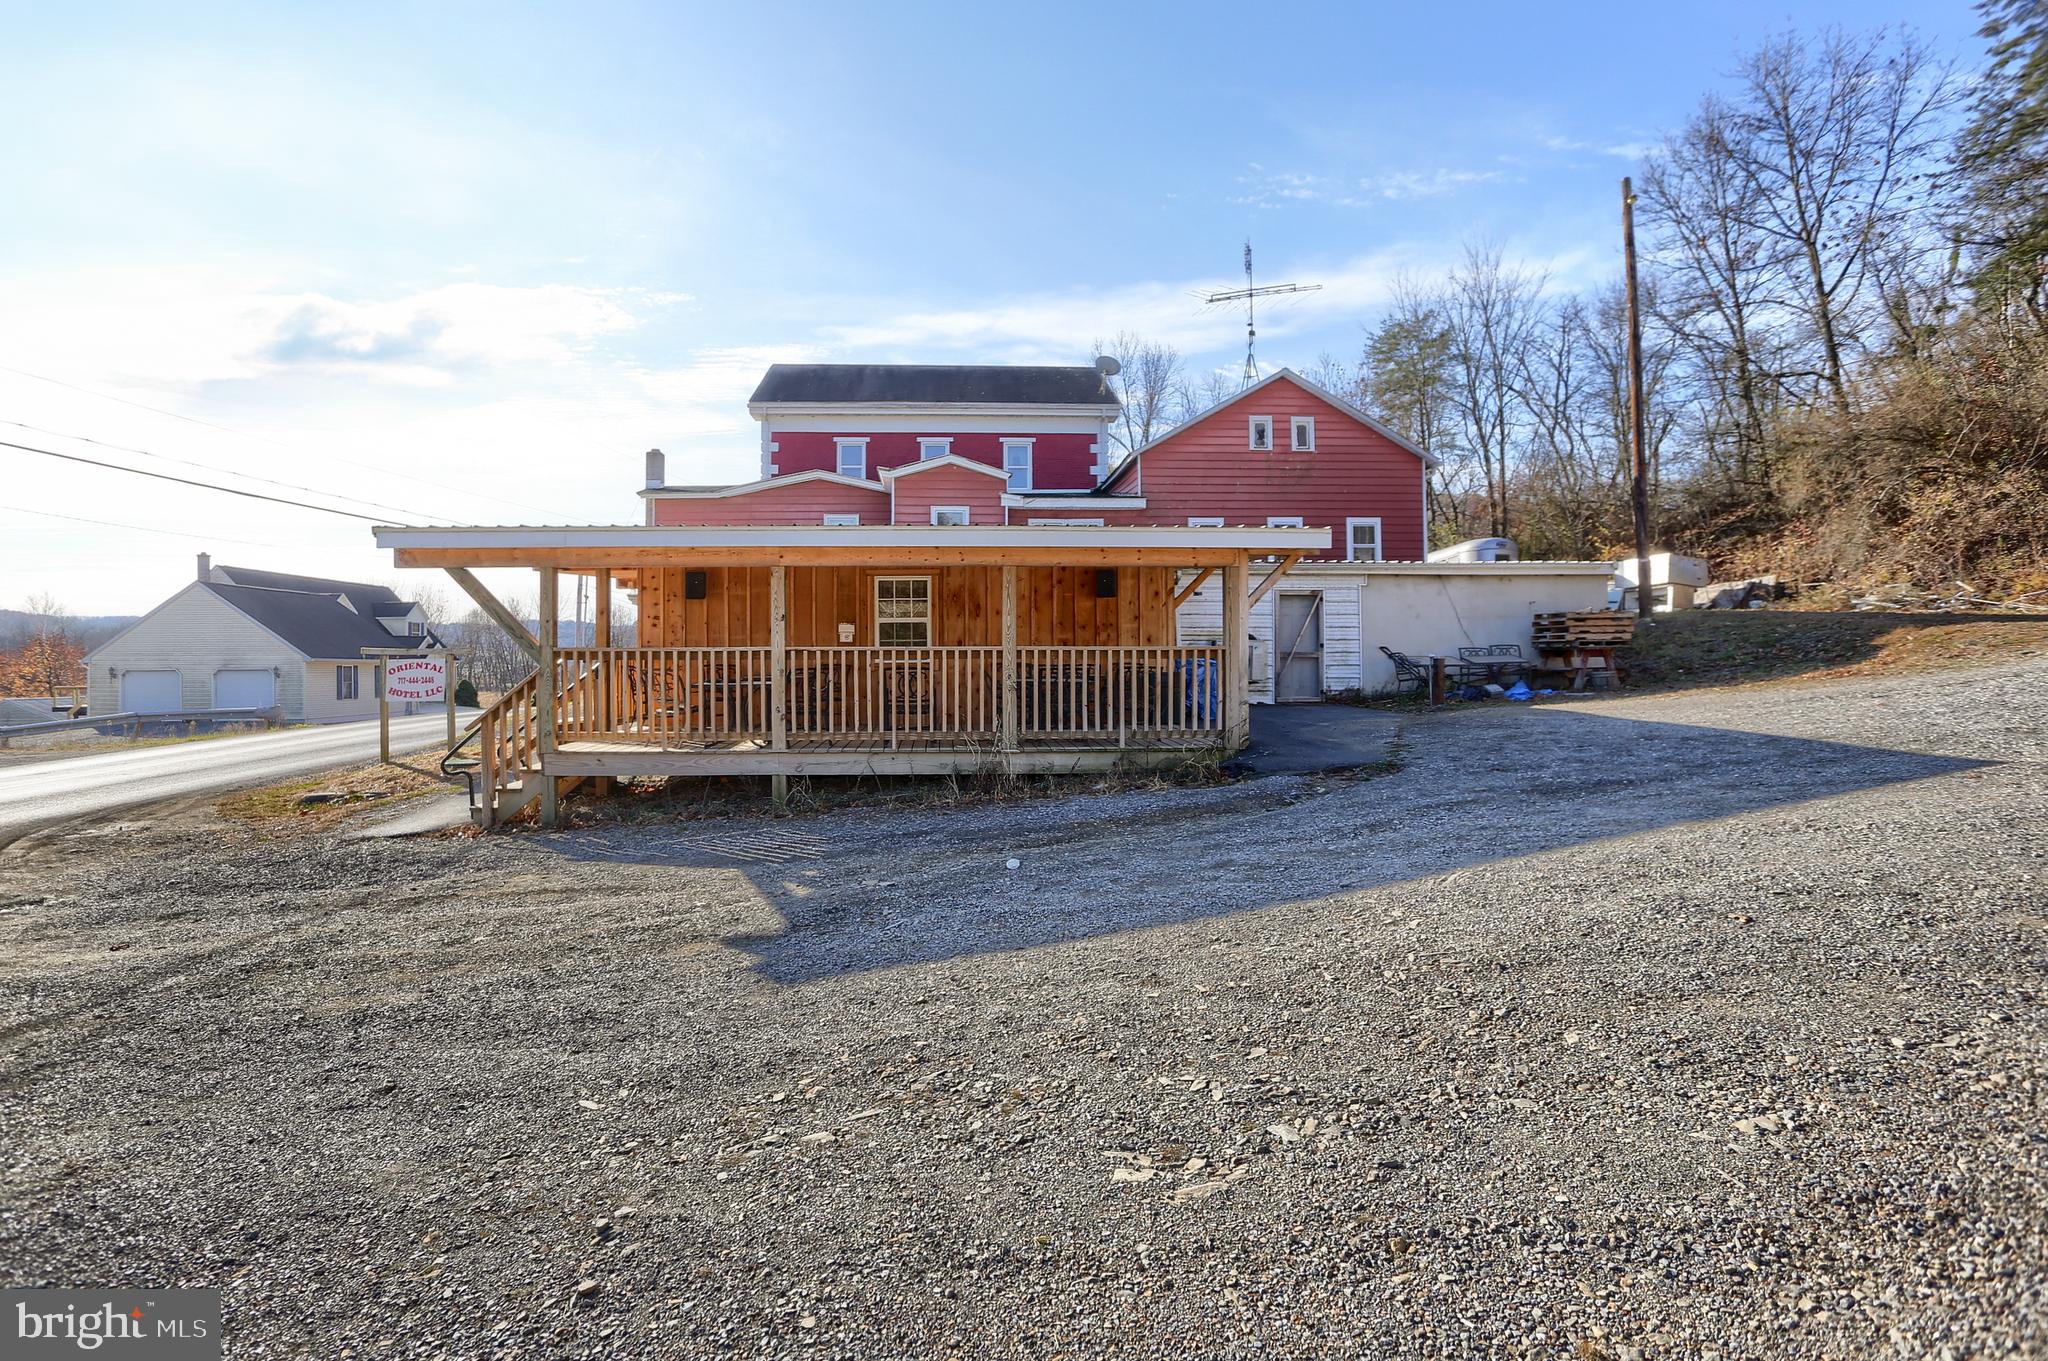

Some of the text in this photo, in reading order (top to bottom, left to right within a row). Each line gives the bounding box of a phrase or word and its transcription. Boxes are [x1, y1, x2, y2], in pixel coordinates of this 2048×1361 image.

[388, 662, 443, 675] ORIENTAL
[388, 685, 443, 698] HOTEL LLC
